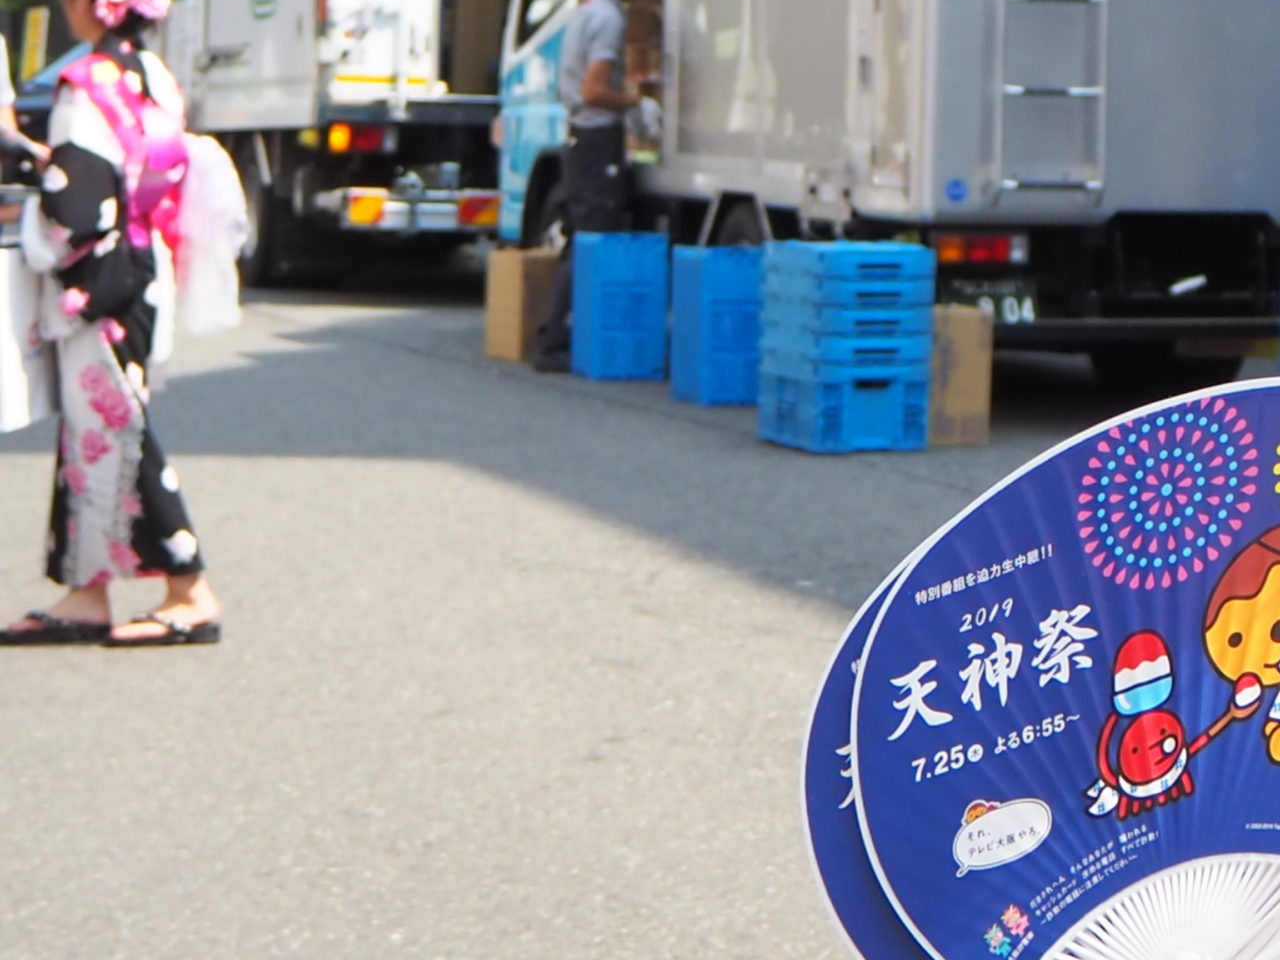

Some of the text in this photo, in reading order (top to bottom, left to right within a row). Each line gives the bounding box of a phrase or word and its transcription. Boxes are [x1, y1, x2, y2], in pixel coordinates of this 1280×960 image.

[914, 543, 1054, 607] 特別番組を迫力生中継!!
[959, 597, 1014, 633] 2019
[886, 603, 1099, 742] 天神祭
